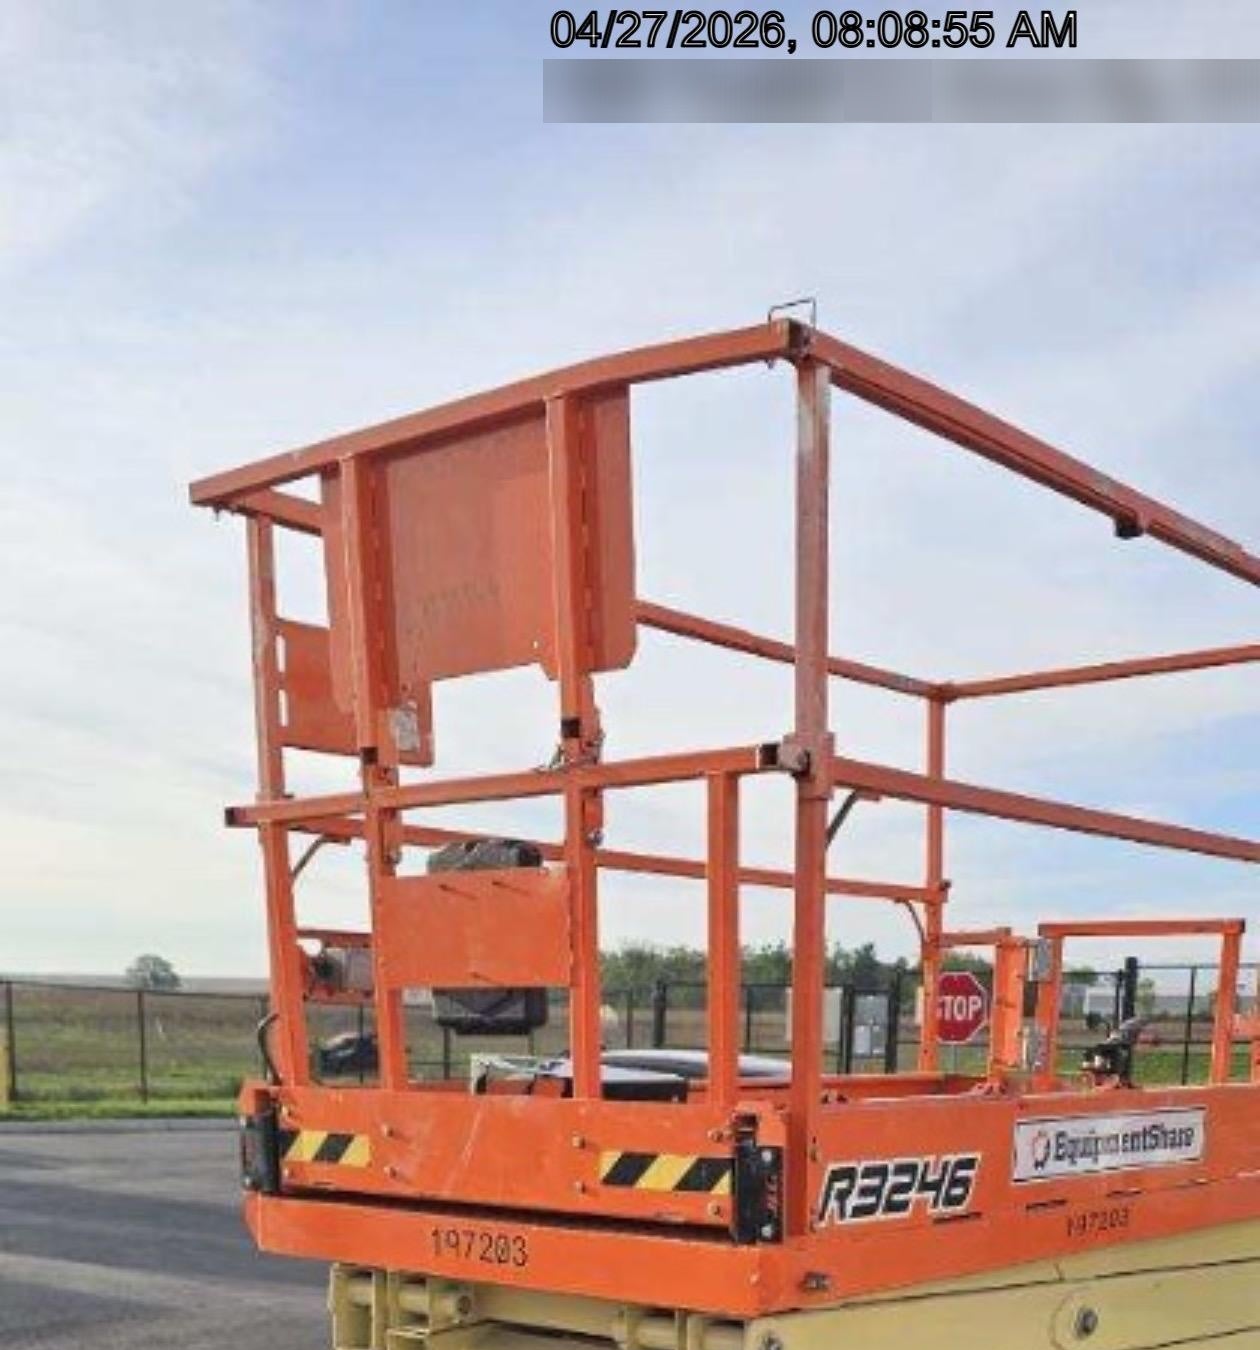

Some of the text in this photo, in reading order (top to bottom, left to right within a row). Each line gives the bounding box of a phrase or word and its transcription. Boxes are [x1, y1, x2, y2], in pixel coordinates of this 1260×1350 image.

[1054, 1123, 1194, 1165] EquipmentShare
[815, 1153, 980, 1225] R3246
[431, 1228, 528, 1267] 197203
